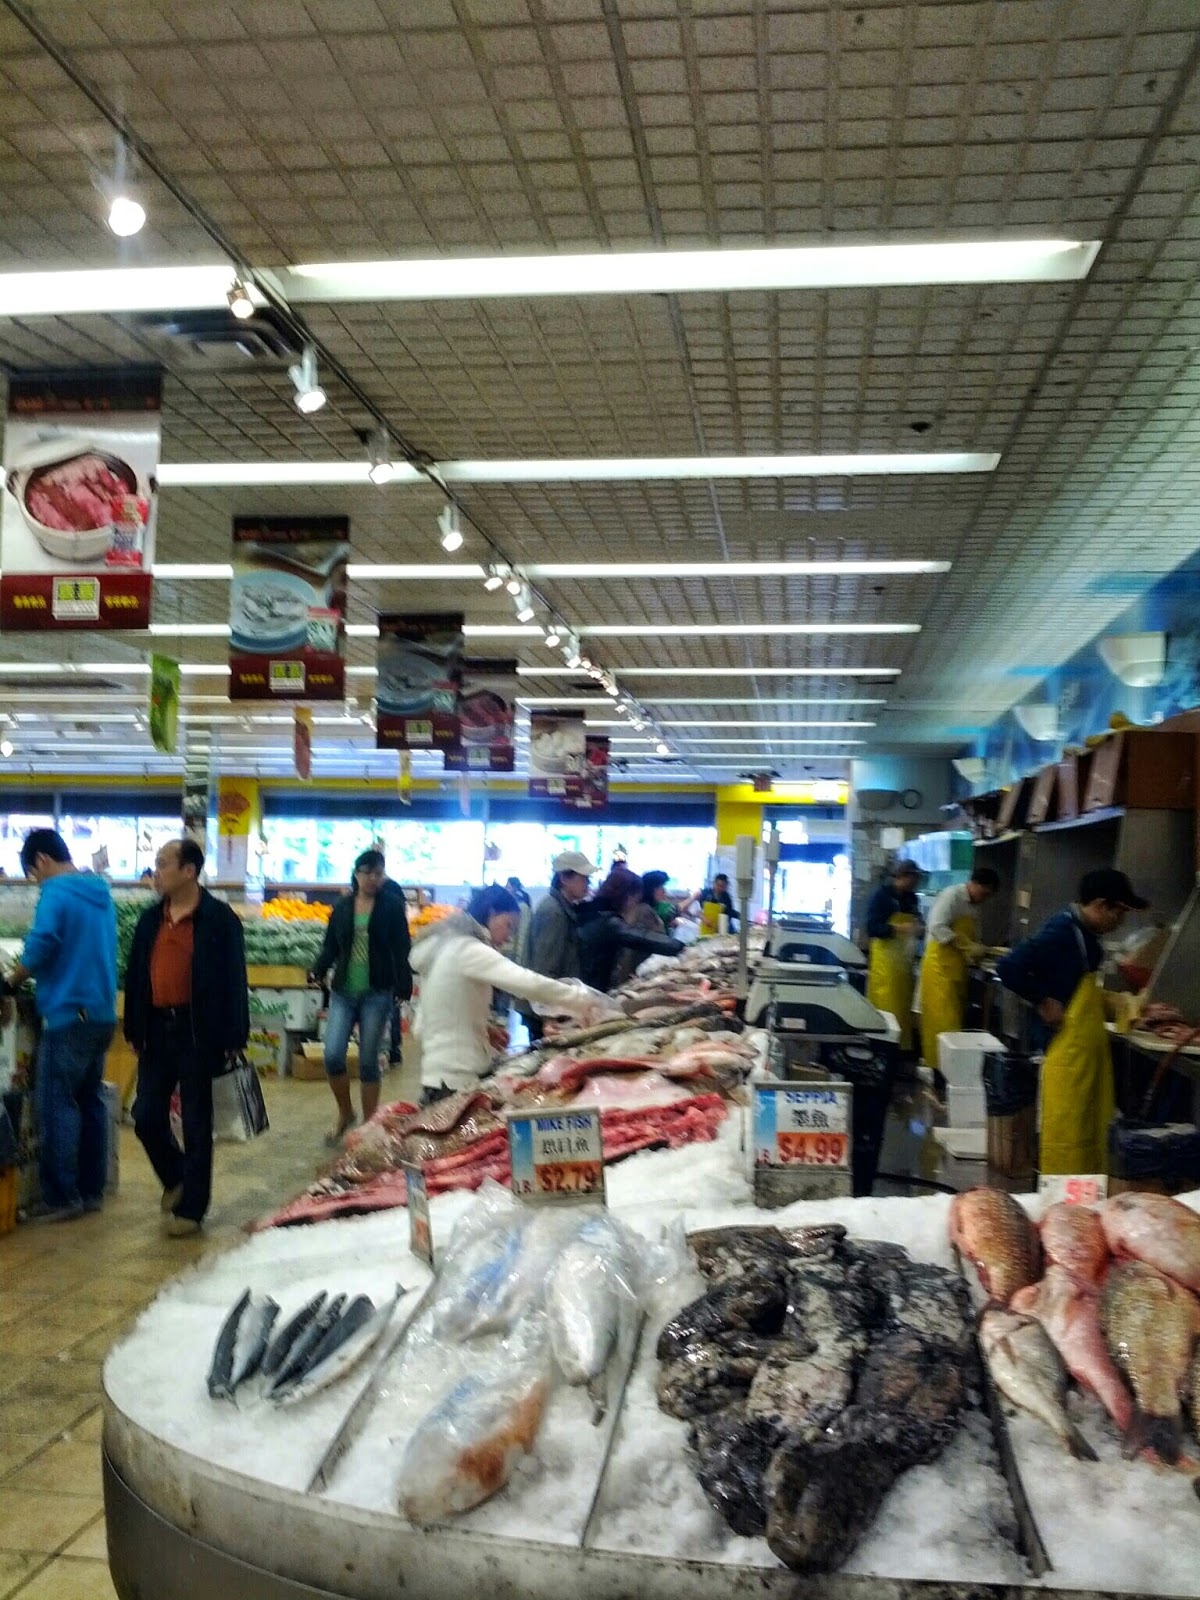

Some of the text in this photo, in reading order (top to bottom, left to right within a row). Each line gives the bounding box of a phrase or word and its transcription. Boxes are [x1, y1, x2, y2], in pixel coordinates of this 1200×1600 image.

[785, 1090, 838, 1105] SEPPIA
[779, 1134, 843, 1164] $4.99
[540, 1163, 598, 1193] $2.79
